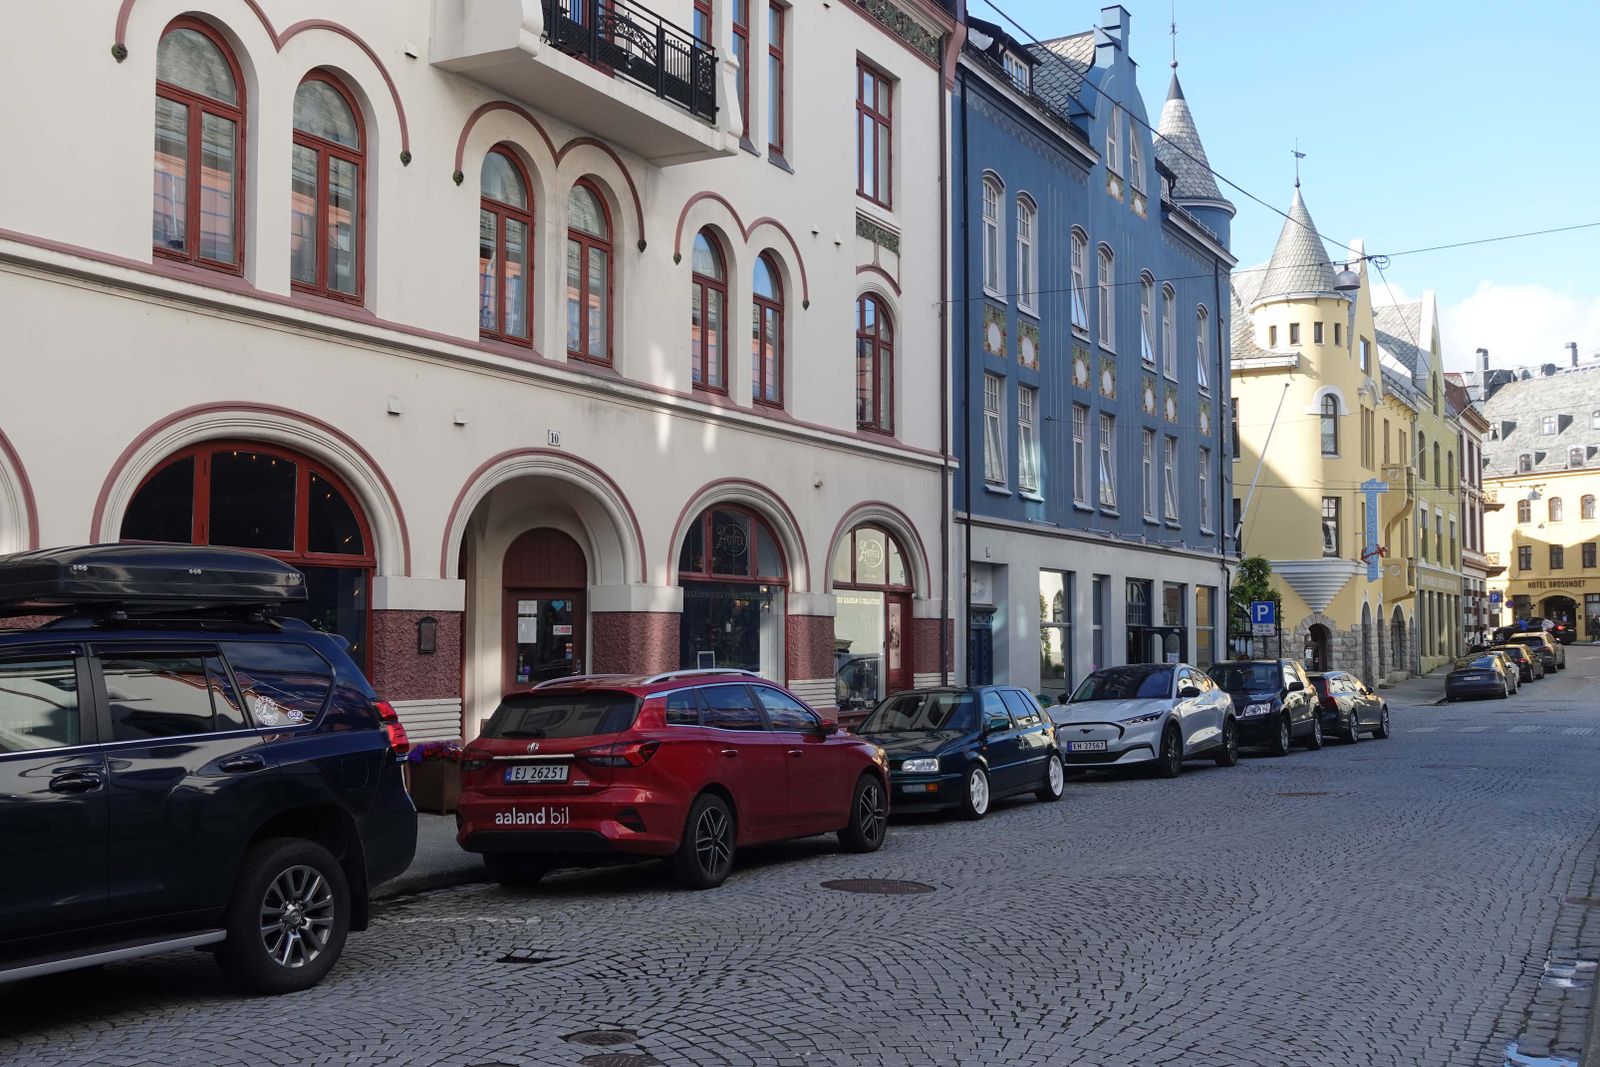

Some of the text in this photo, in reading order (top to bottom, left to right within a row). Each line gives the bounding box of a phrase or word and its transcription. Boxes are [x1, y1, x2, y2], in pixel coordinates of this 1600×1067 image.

[551, 432, 559, 444] 10
[1527, 580, 1585, 589] HOTEL BROSUNDET
[1257, 604, 1269, 621] P
[1084, 742, 1104, 750] 27567
[514, 767, 564, 779] EJ 26251
[495, 806, 569, 825] aaland bil
